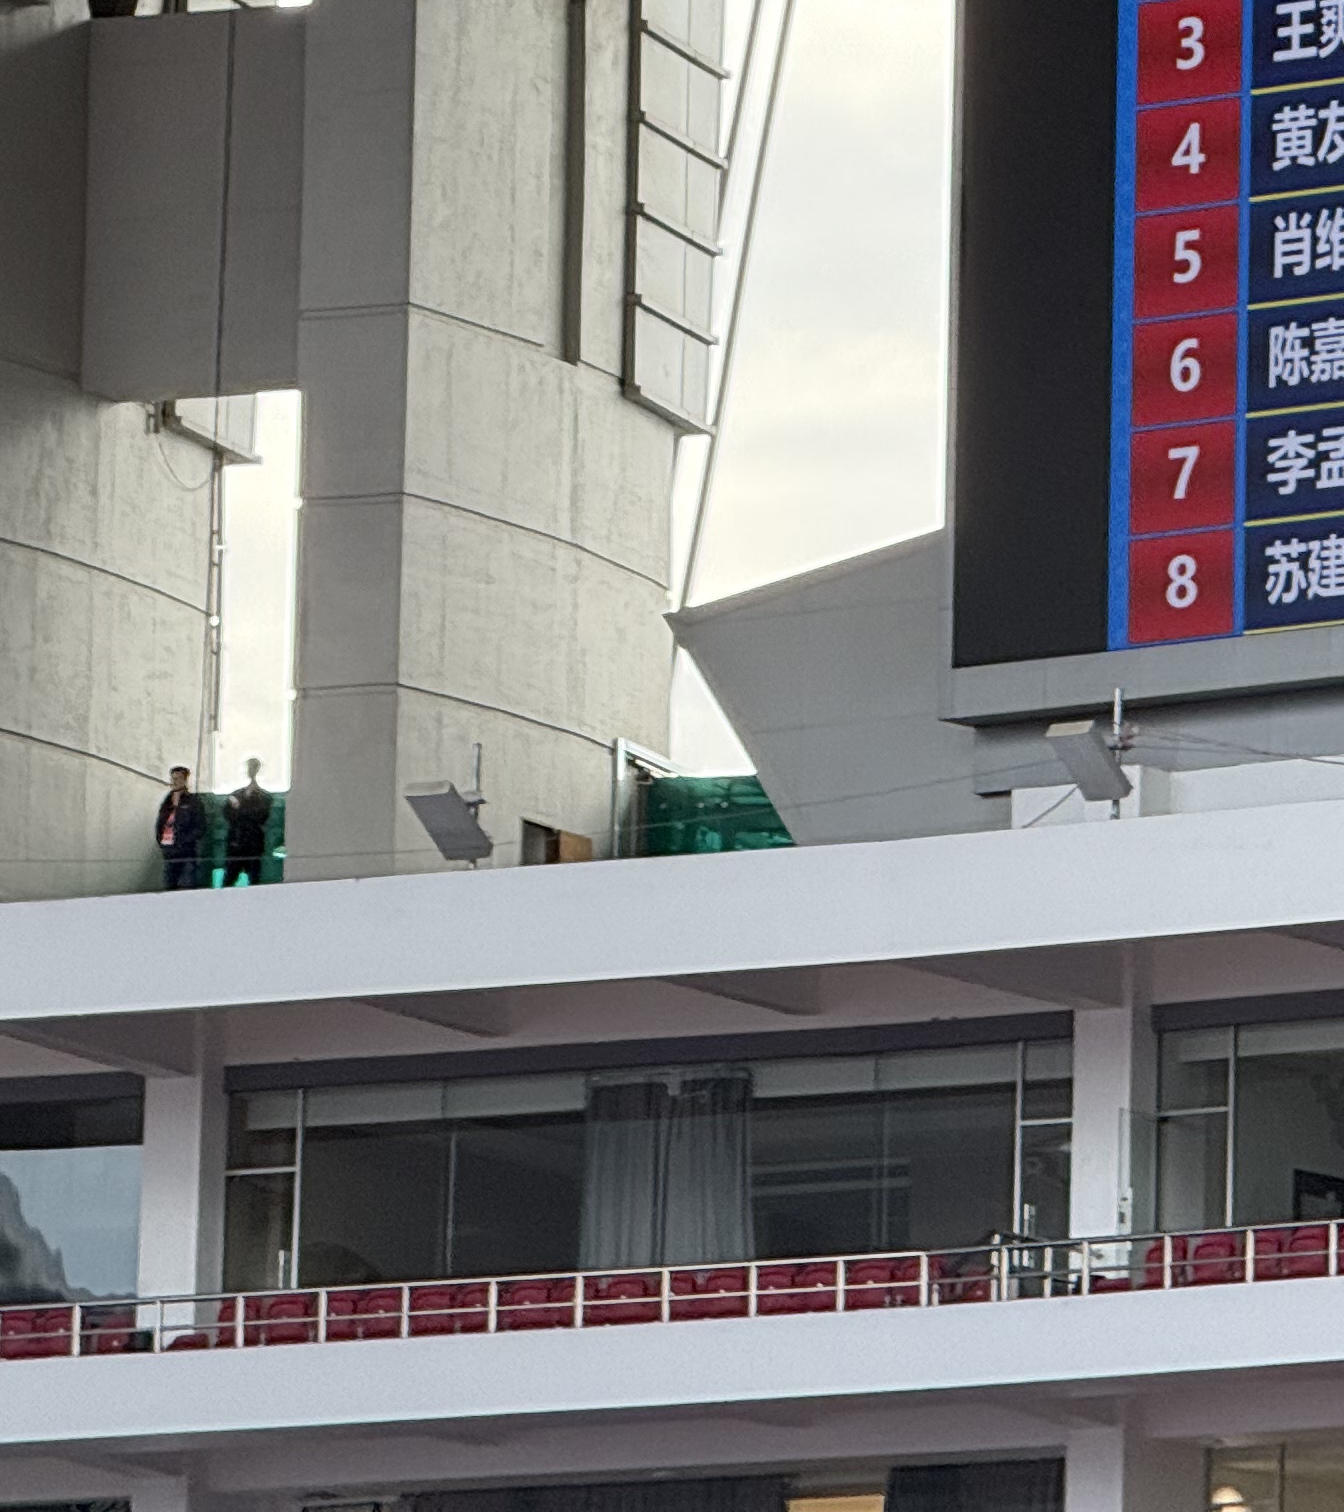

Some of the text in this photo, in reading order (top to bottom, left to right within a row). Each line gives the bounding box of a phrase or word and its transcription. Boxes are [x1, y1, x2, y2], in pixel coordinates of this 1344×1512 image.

[1177, 17, 1203, 69] 3
[1172, 123, 1205, 173] 4
[1174, 230, 1200, 283] 5
[1171, 339, 1200, 391] 6
[1169, 447, 1198, 498] 7
[1167, 555, 1197, 607] 8
